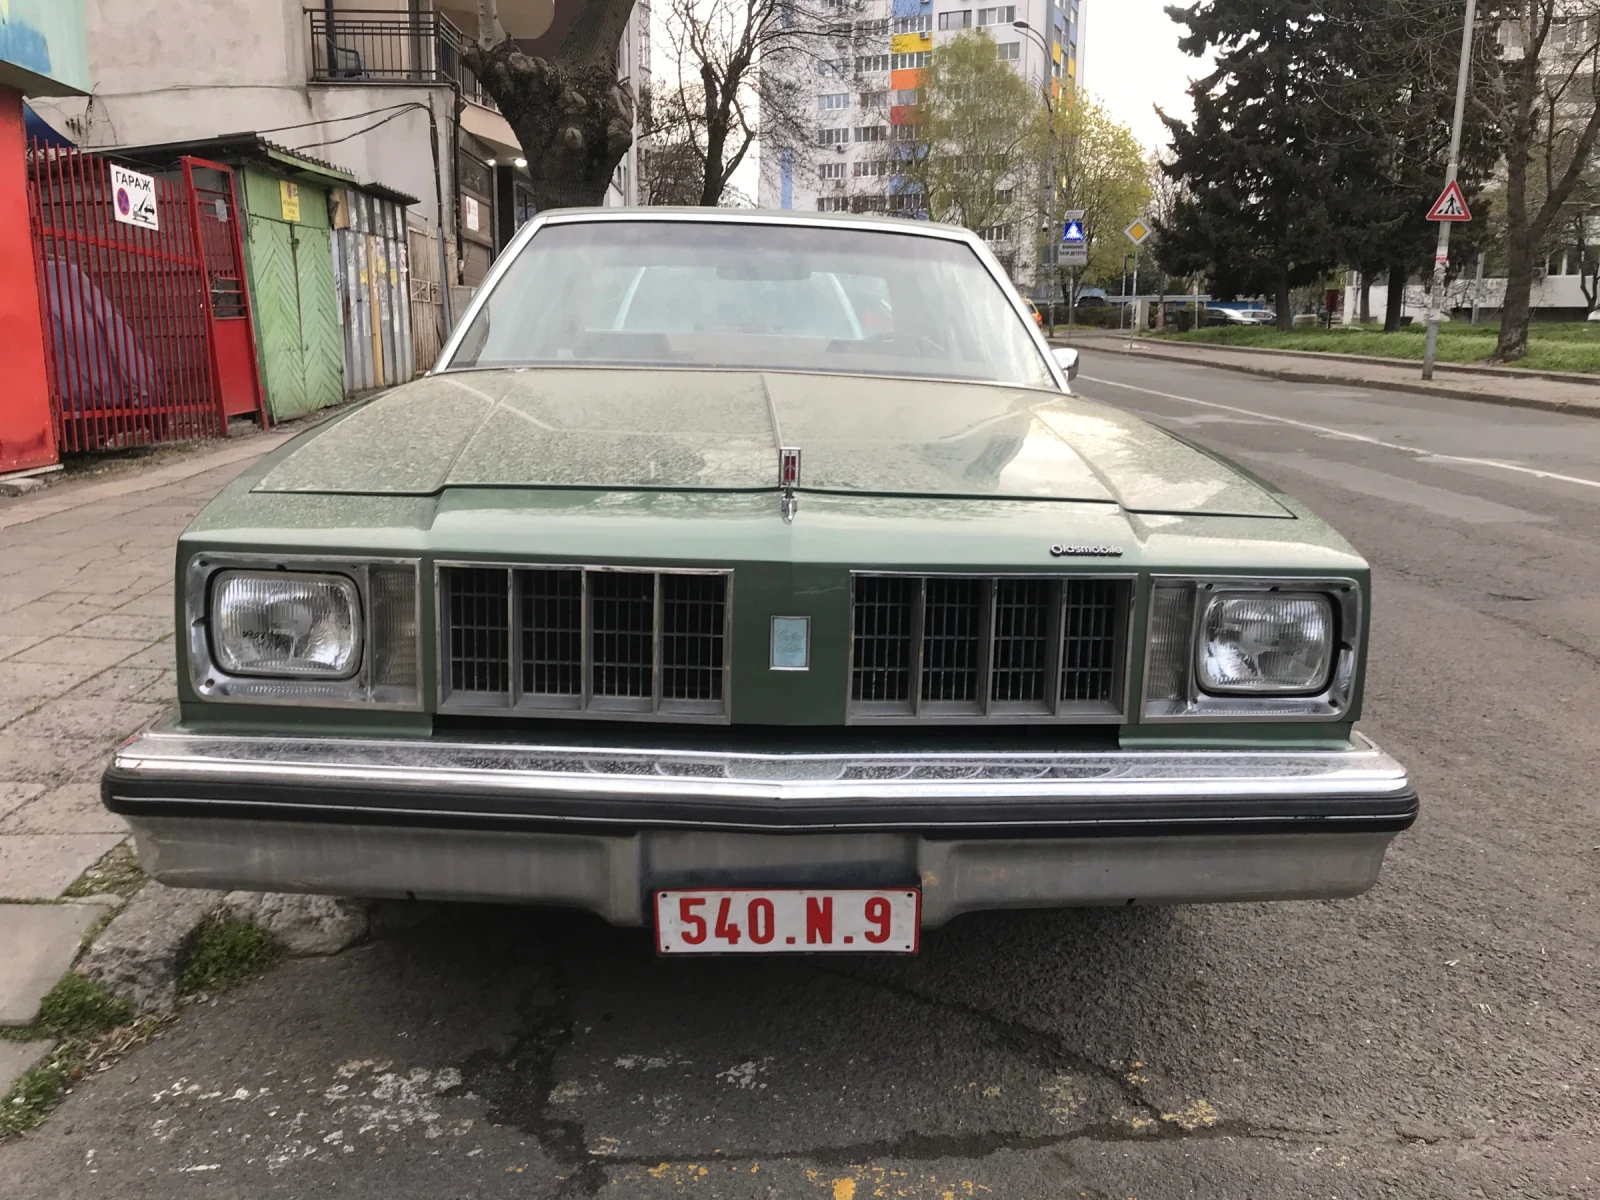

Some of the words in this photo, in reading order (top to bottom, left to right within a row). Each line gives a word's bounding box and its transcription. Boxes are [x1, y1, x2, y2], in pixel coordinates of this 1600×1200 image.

[115, 171, 152, 193] ГАРАЖ
[1050, 544, 1123, 556] Oldsmobile
[679, 896, 892, 945] 540.N.9
